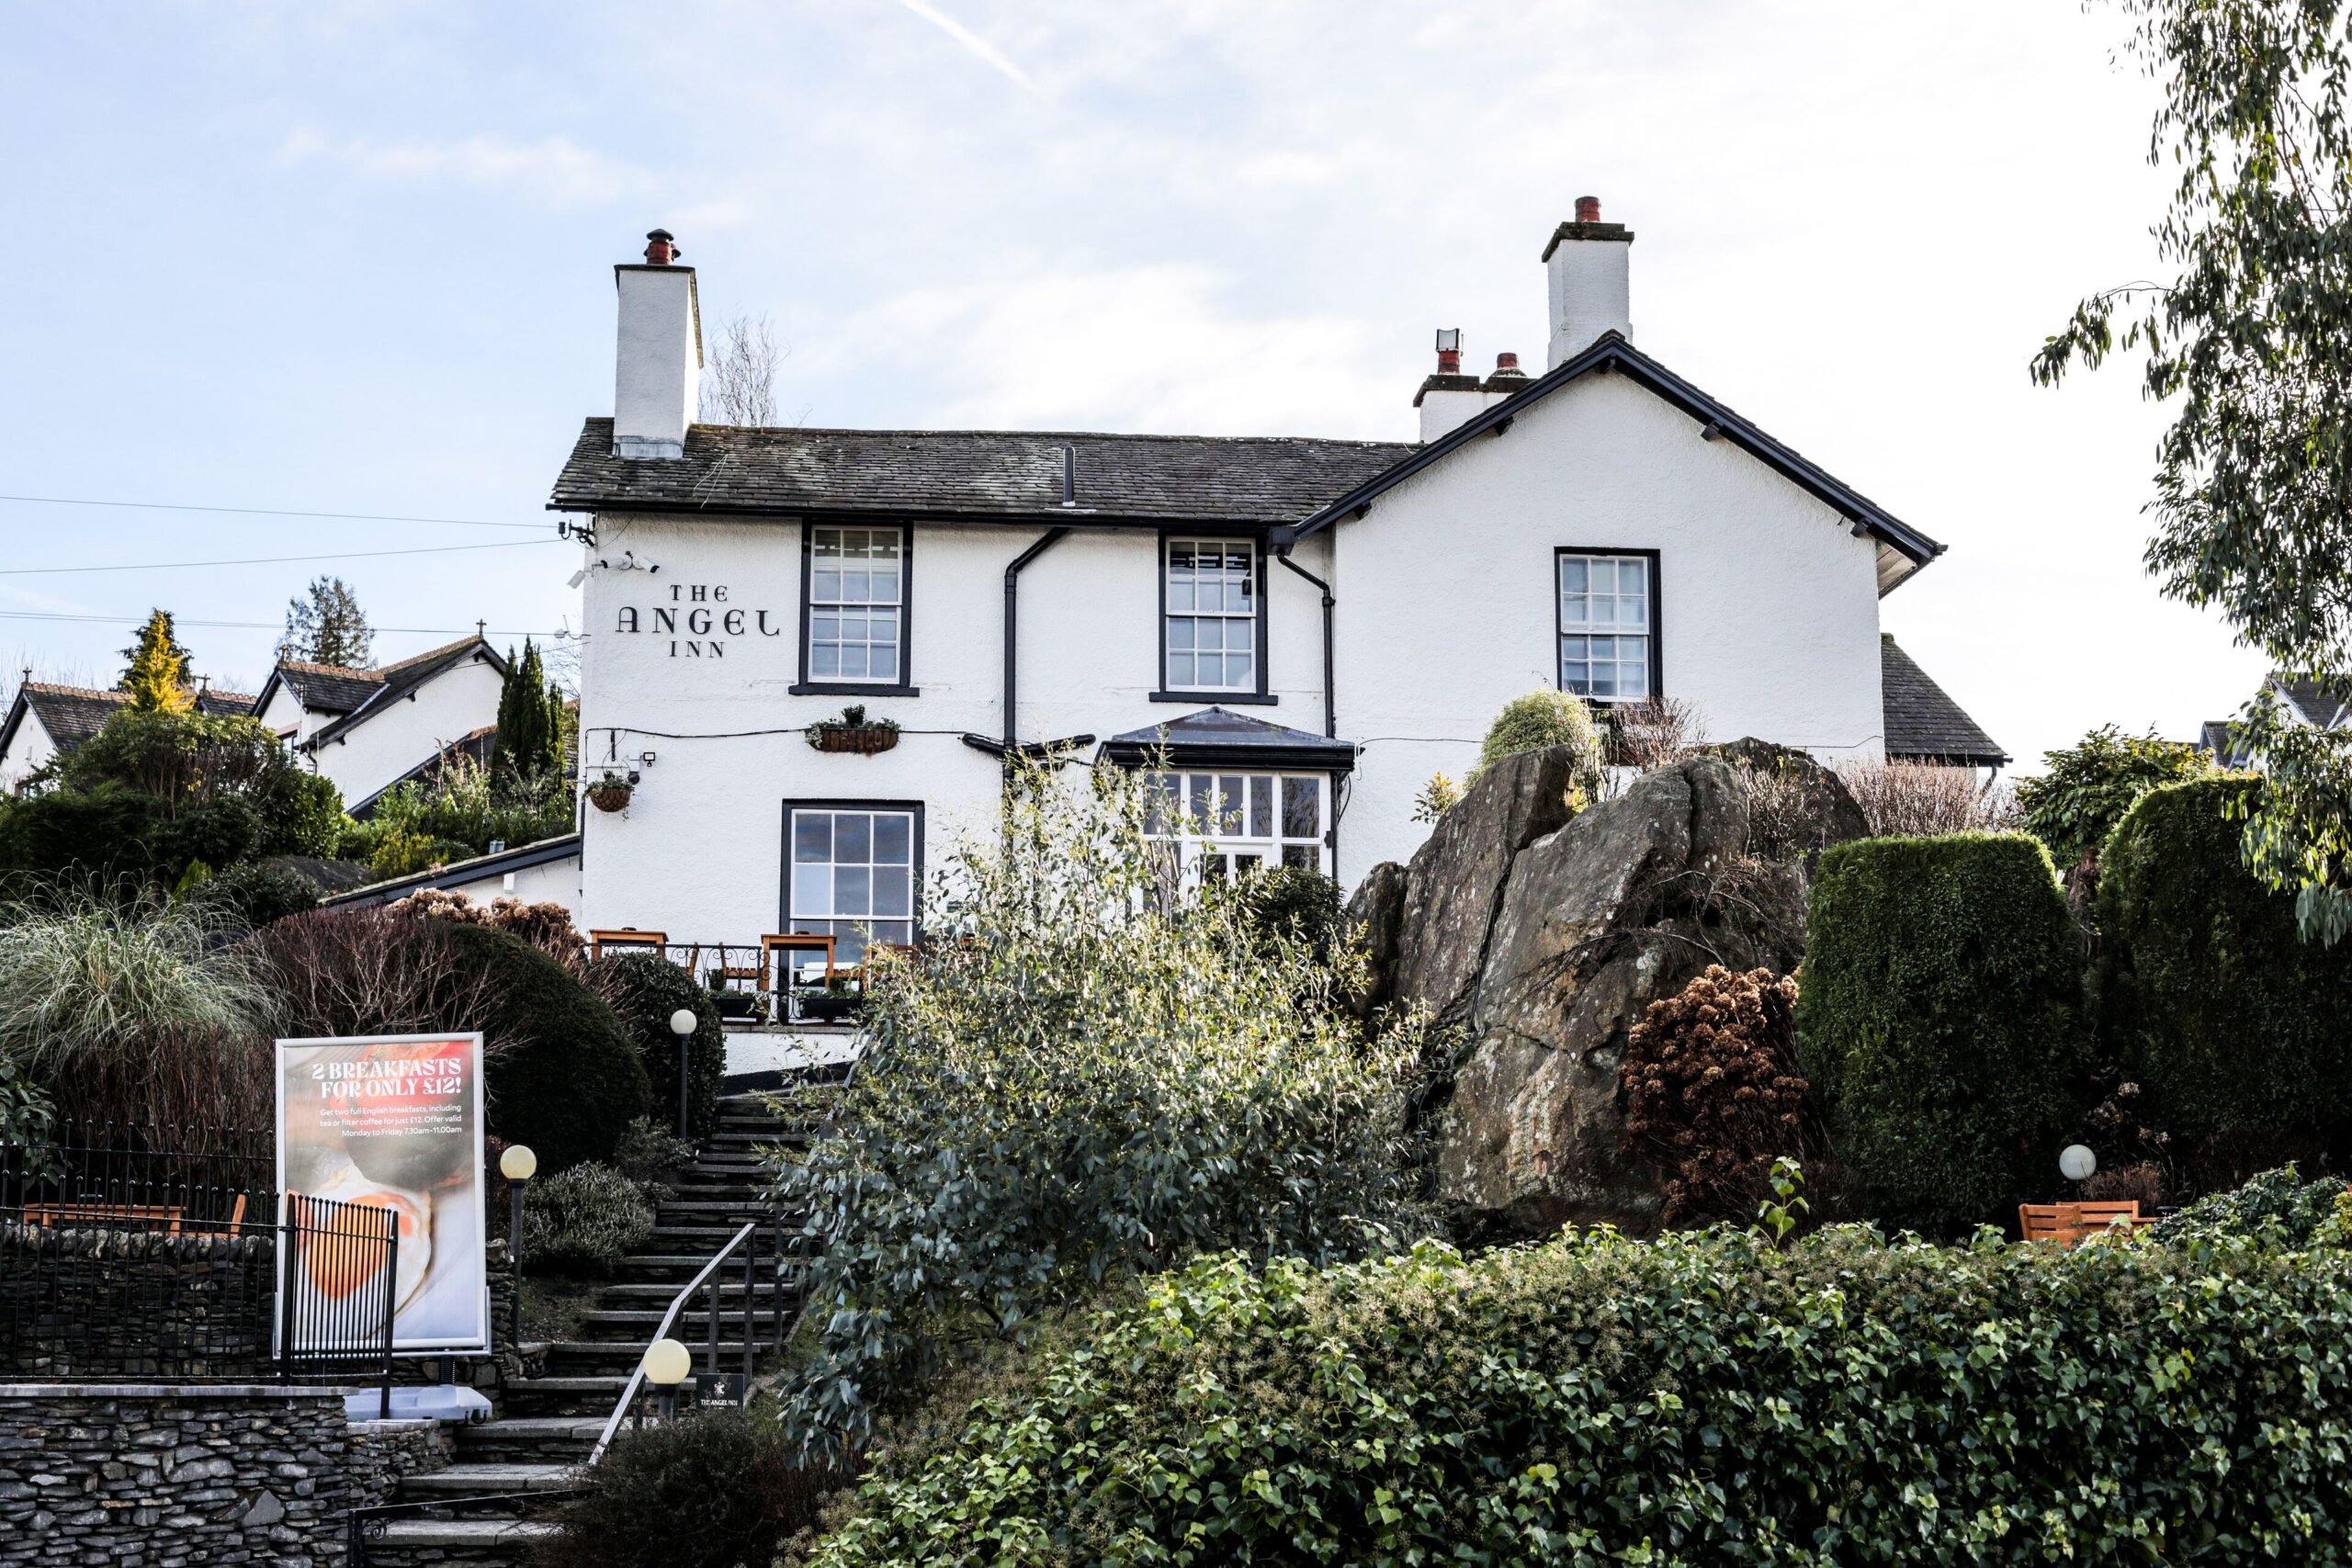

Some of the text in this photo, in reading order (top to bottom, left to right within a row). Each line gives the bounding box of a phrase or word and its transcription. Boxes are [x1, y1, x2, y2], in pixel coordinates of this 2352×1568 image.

[669, 584, 729, 603] THE
[615, 606, 780, 637] ANGEL
[669, 640, 725, 658] INN
[311, 1058, 461, 1080] 2 BREAKFASTS
[322, 1077, 461, 1099] FOR ONLY £12!
[363, 1107, 389, 1116] English
[390, 1105, 428, 1113] breakfasts,
[429, 1104, 461, 1112] including
[394, 1117, 409, 1125] just
[424, 1115, 444, 1123] Offer
[445, 1114, 461, 1122] valid
[342, 1129, 371, 1138] Monday
[381, 1128, 403, 1136] Friday
